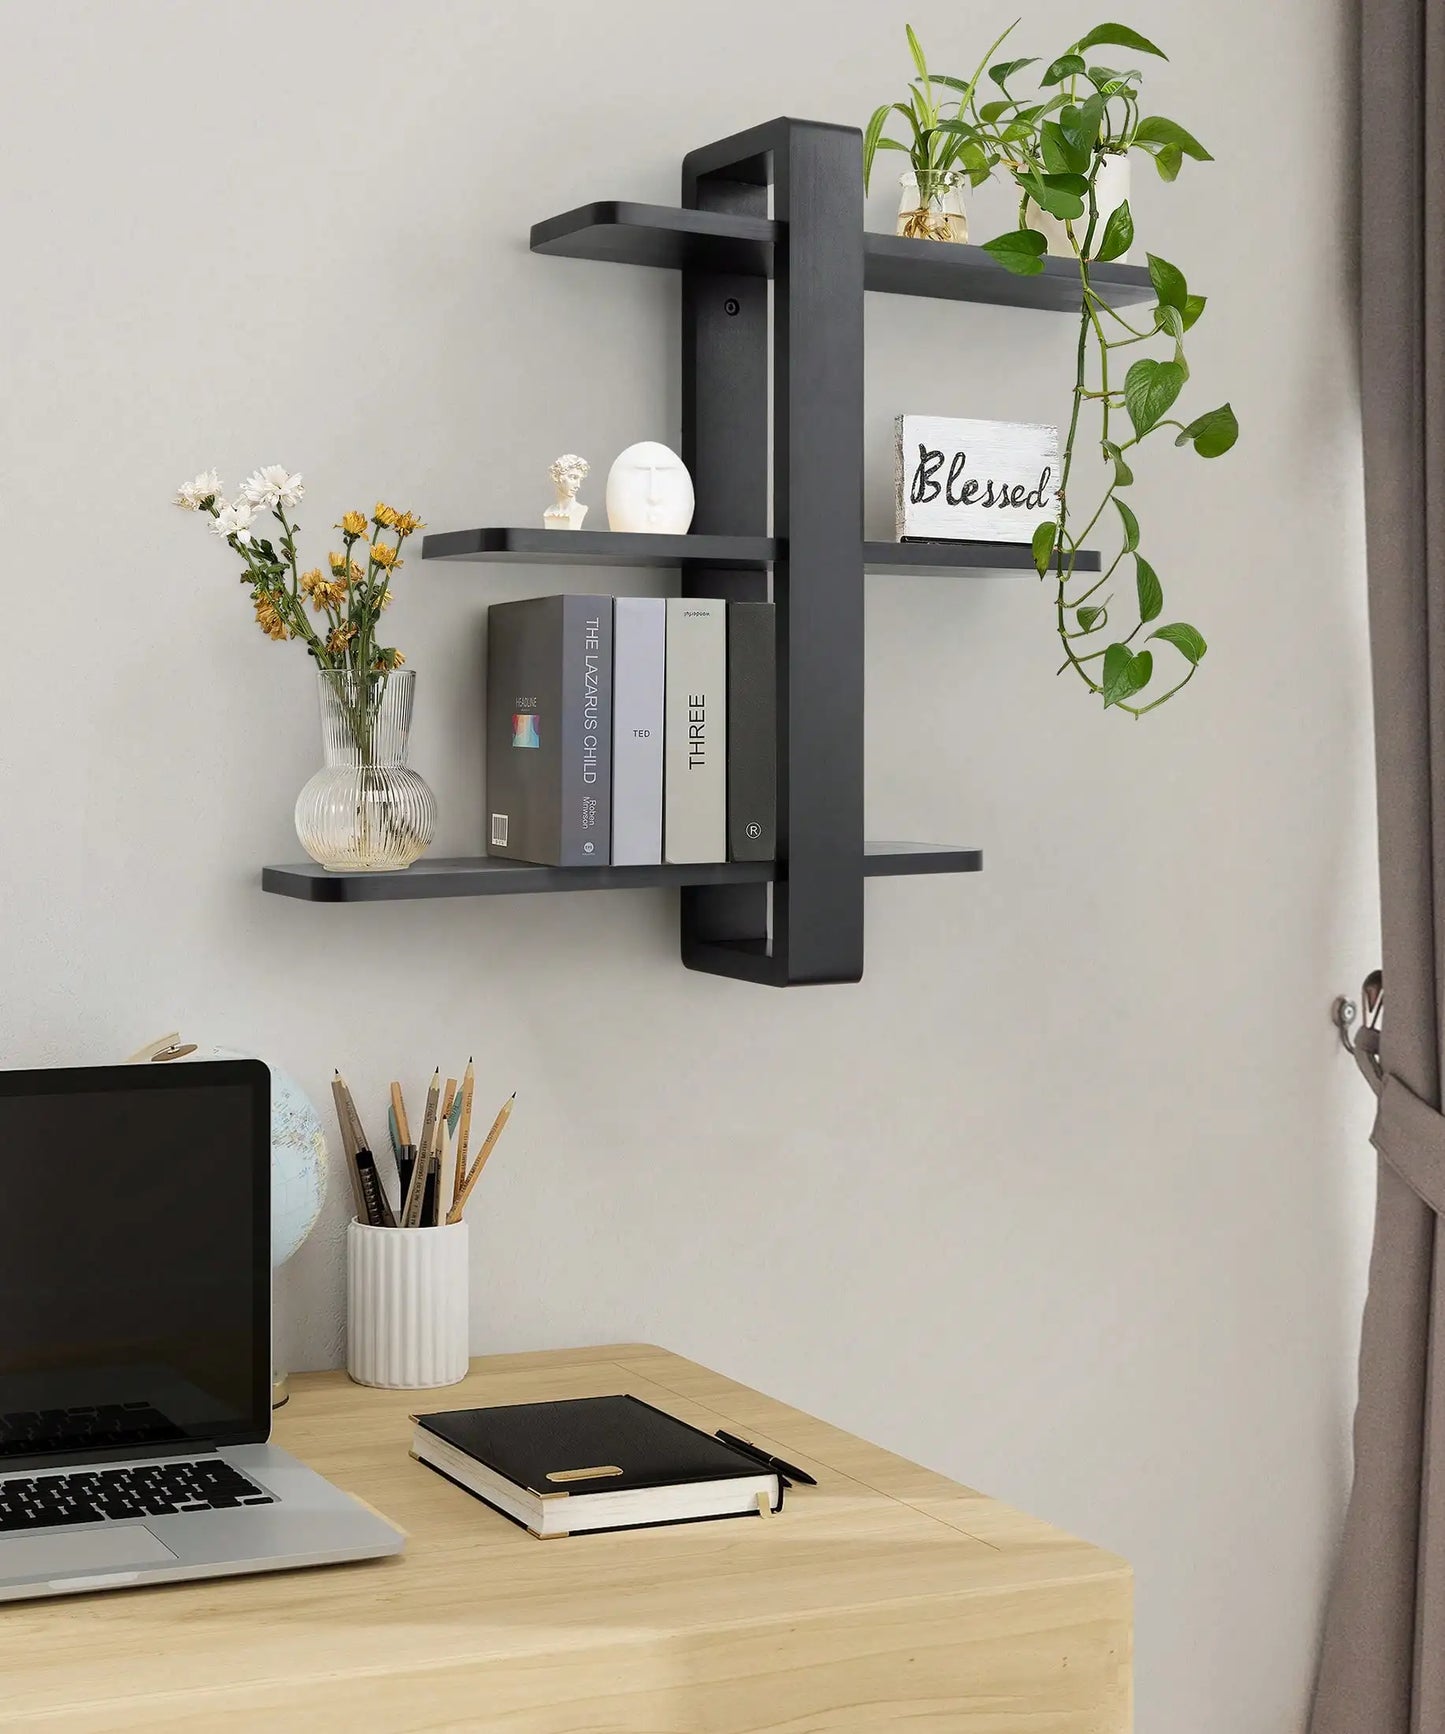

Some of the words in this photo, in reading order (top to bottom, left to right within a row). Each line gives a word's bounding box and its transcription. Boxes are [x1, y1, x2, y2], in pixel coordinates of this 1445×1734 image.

[910, 443, 1051, 510] Blessed
[585, 617, 599, 650] THE
[584, 655, 599, 730] LAZARUS
[583, 736, 597, 784] CHILD
[633, 729, 651, 739] TED
[689, 694, 705, 770] THREE
